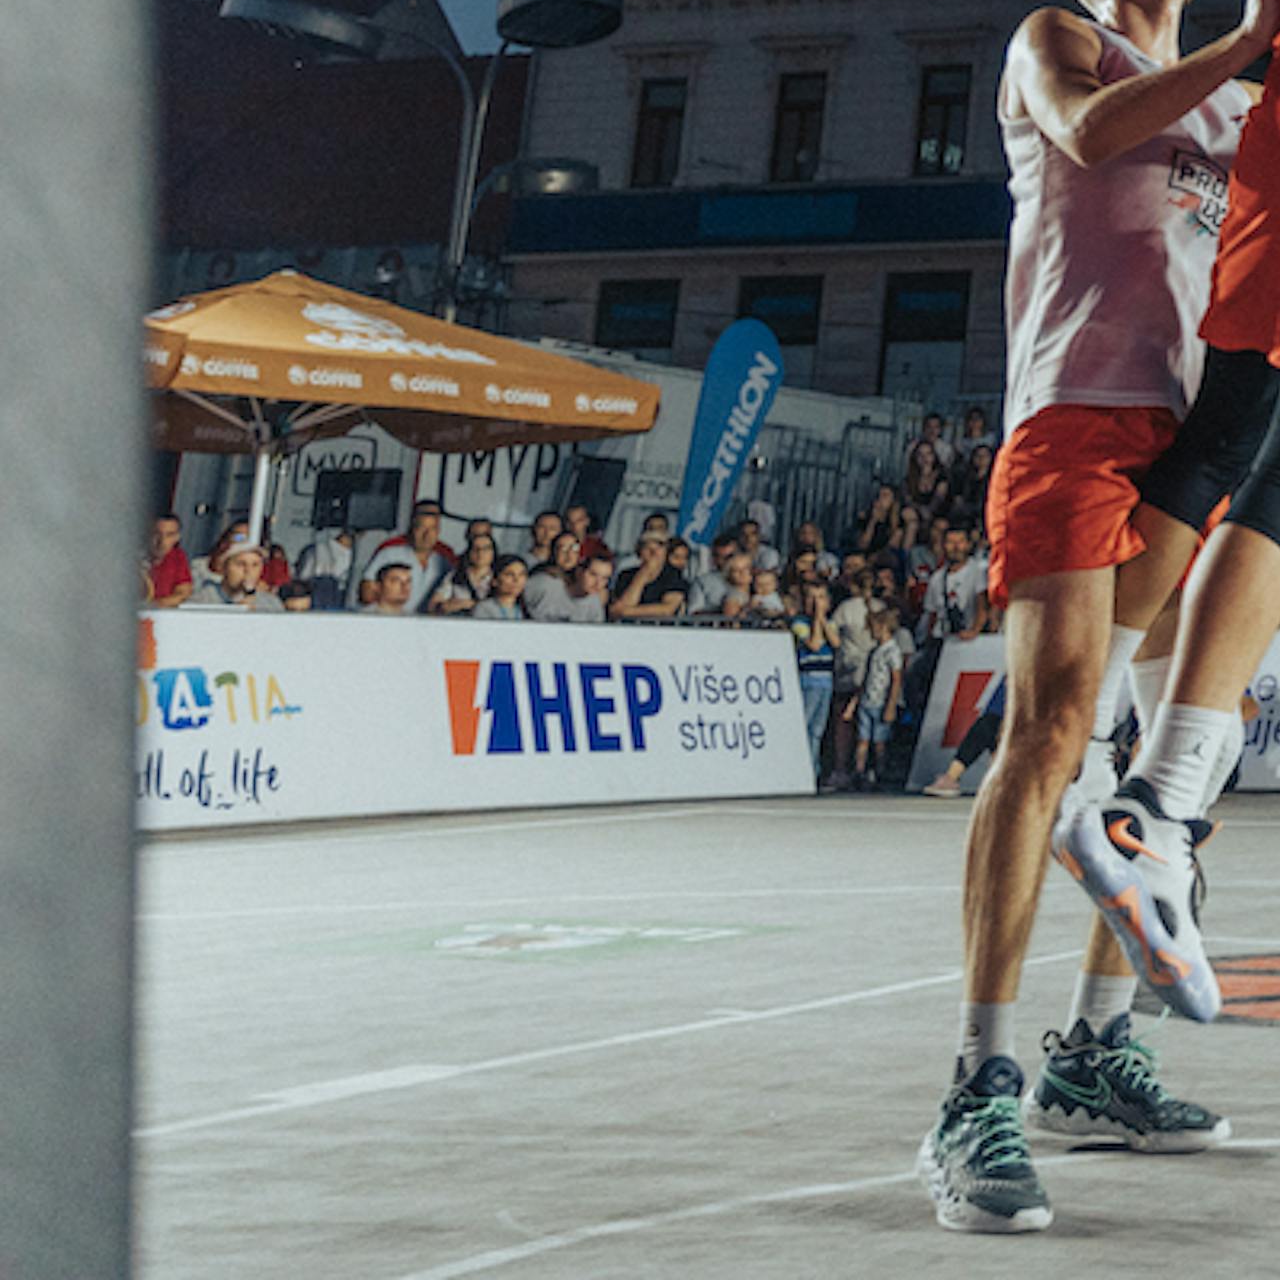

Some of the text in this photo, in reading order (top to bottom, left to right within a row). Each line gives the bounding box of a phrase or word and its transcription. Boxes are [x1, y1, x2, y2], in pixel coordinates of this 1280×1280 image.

[458, 444, 561, 490] MVP
[680, 351, 779, 548] DECATHLON
[525, 660, 663, 753] HEP
[672, 664, 784, 705] Više od
[680, 713, 766, 763] struje
[179, 749, 214, 807] of
[232, 747, 282, 805] life
